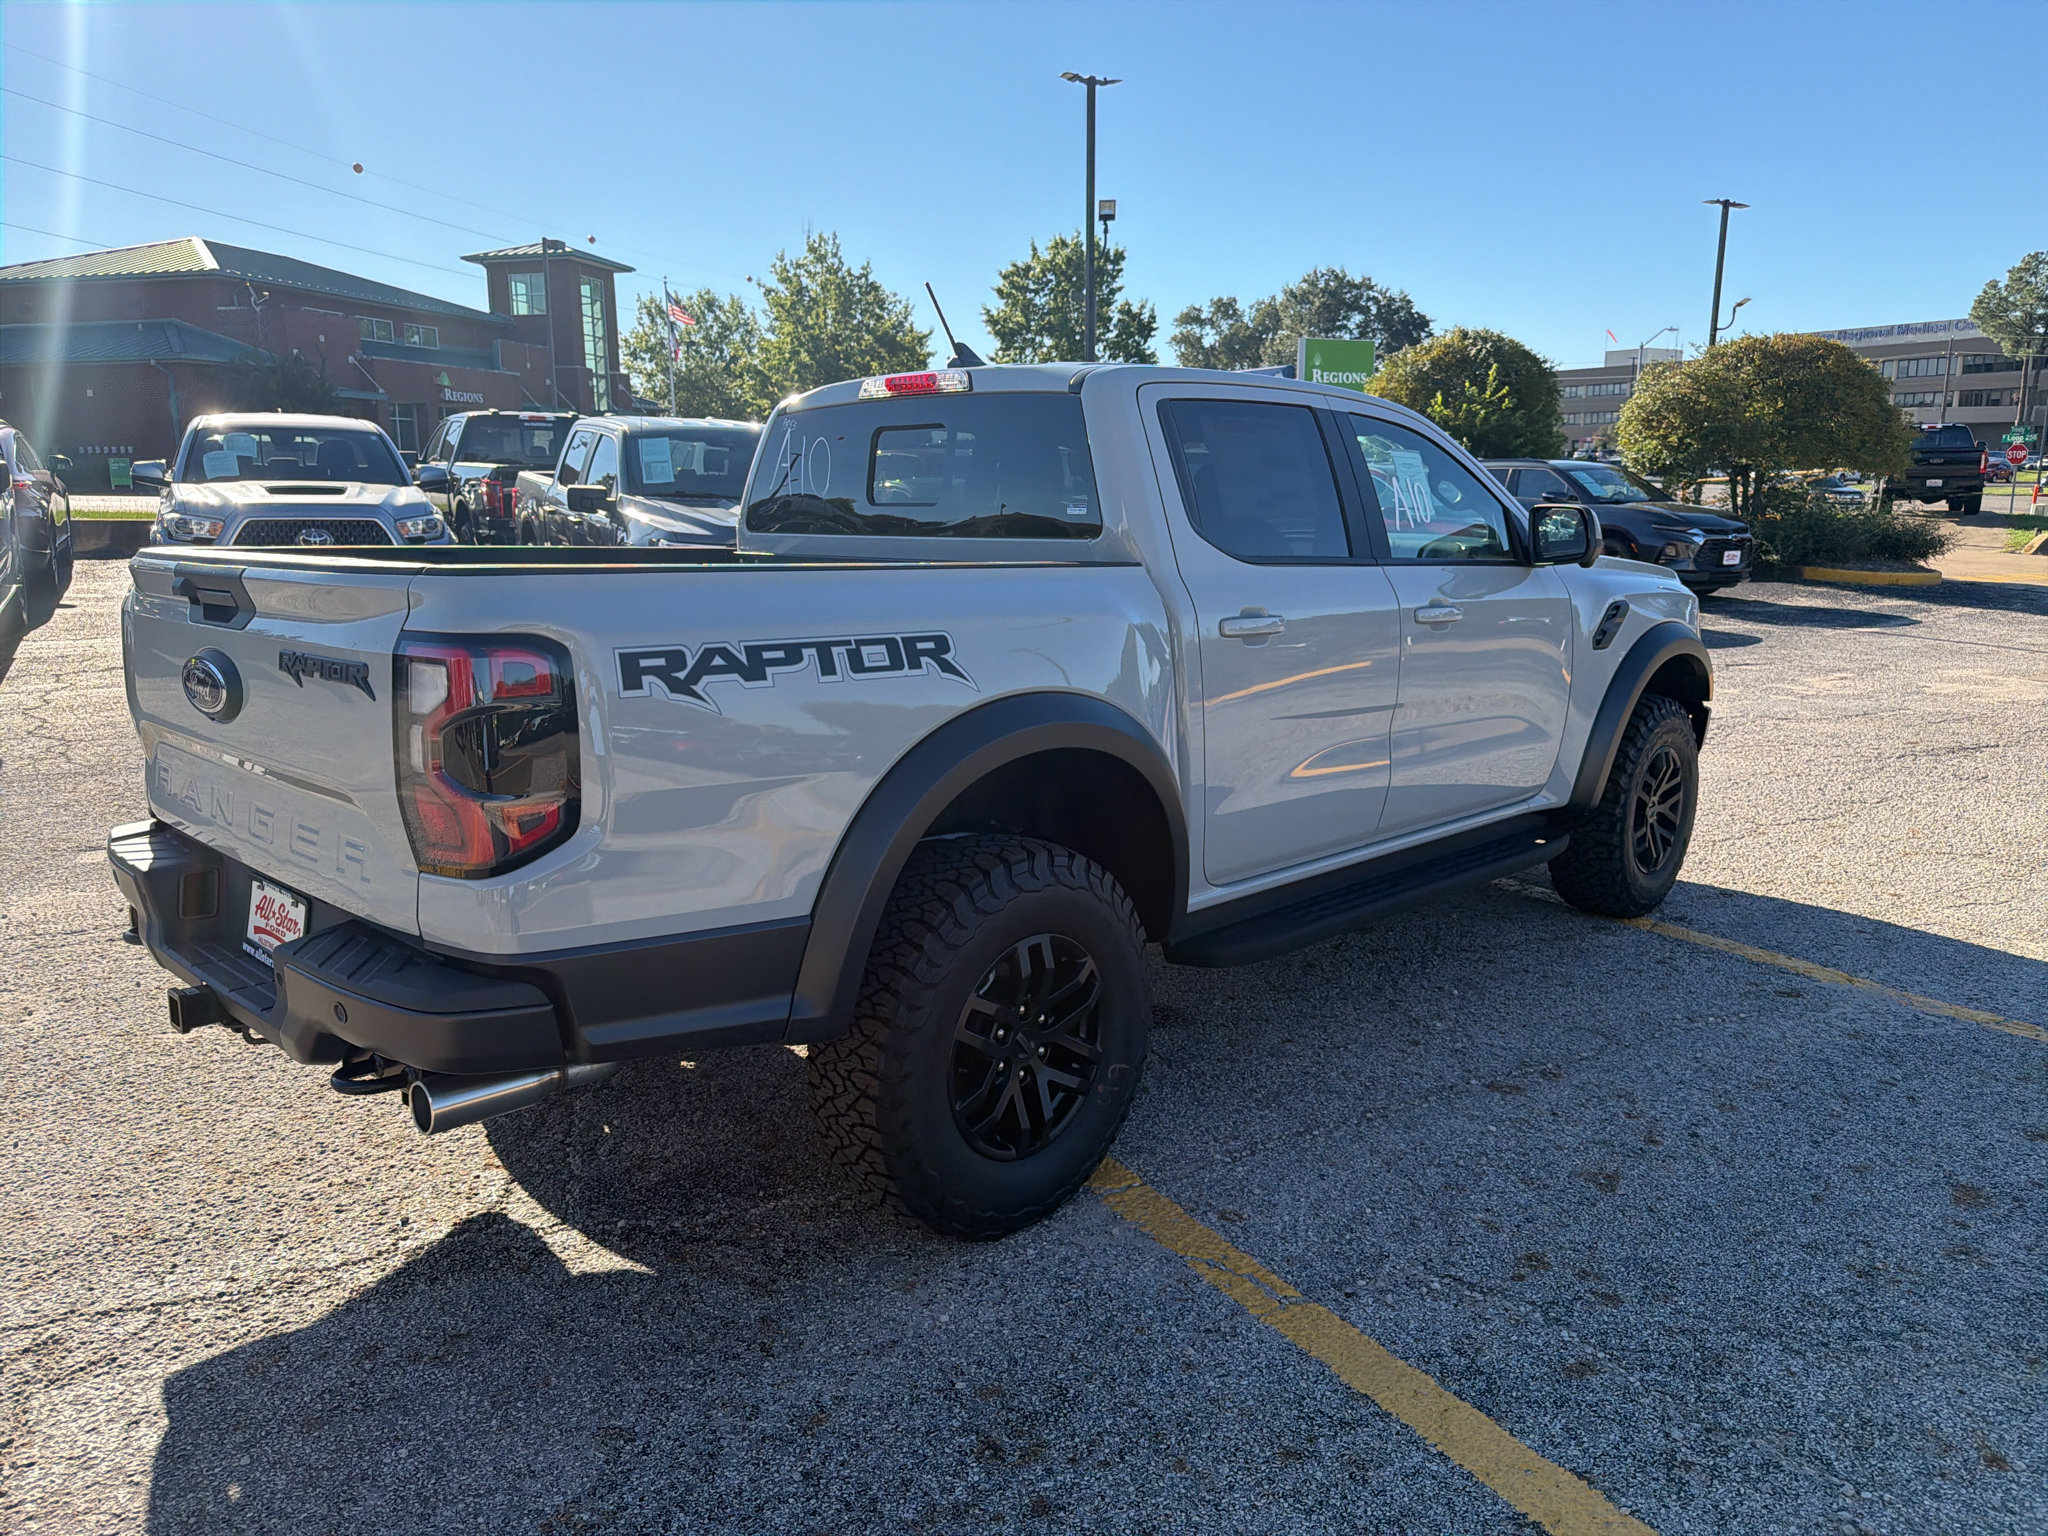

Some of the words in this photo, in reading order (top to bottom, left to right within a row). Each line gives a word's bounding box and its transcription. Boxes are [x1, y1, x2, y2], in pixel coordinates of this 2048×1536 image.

[1837, 326, 1894, 342] Regional
[1897, 320, 1951, 336] Medical
[1312, 369, 1367, 384] REGIONS
[444, 388, 484, 404] REGIONS
[2007, 451, 2027, 459] STOP
[278, 649, 376, 702] RAPTOR
[612, 630, 980, 716] RAPTOR
[155, 759, 373, 884] RANGER
[265, 922, 287, 938] FORD
